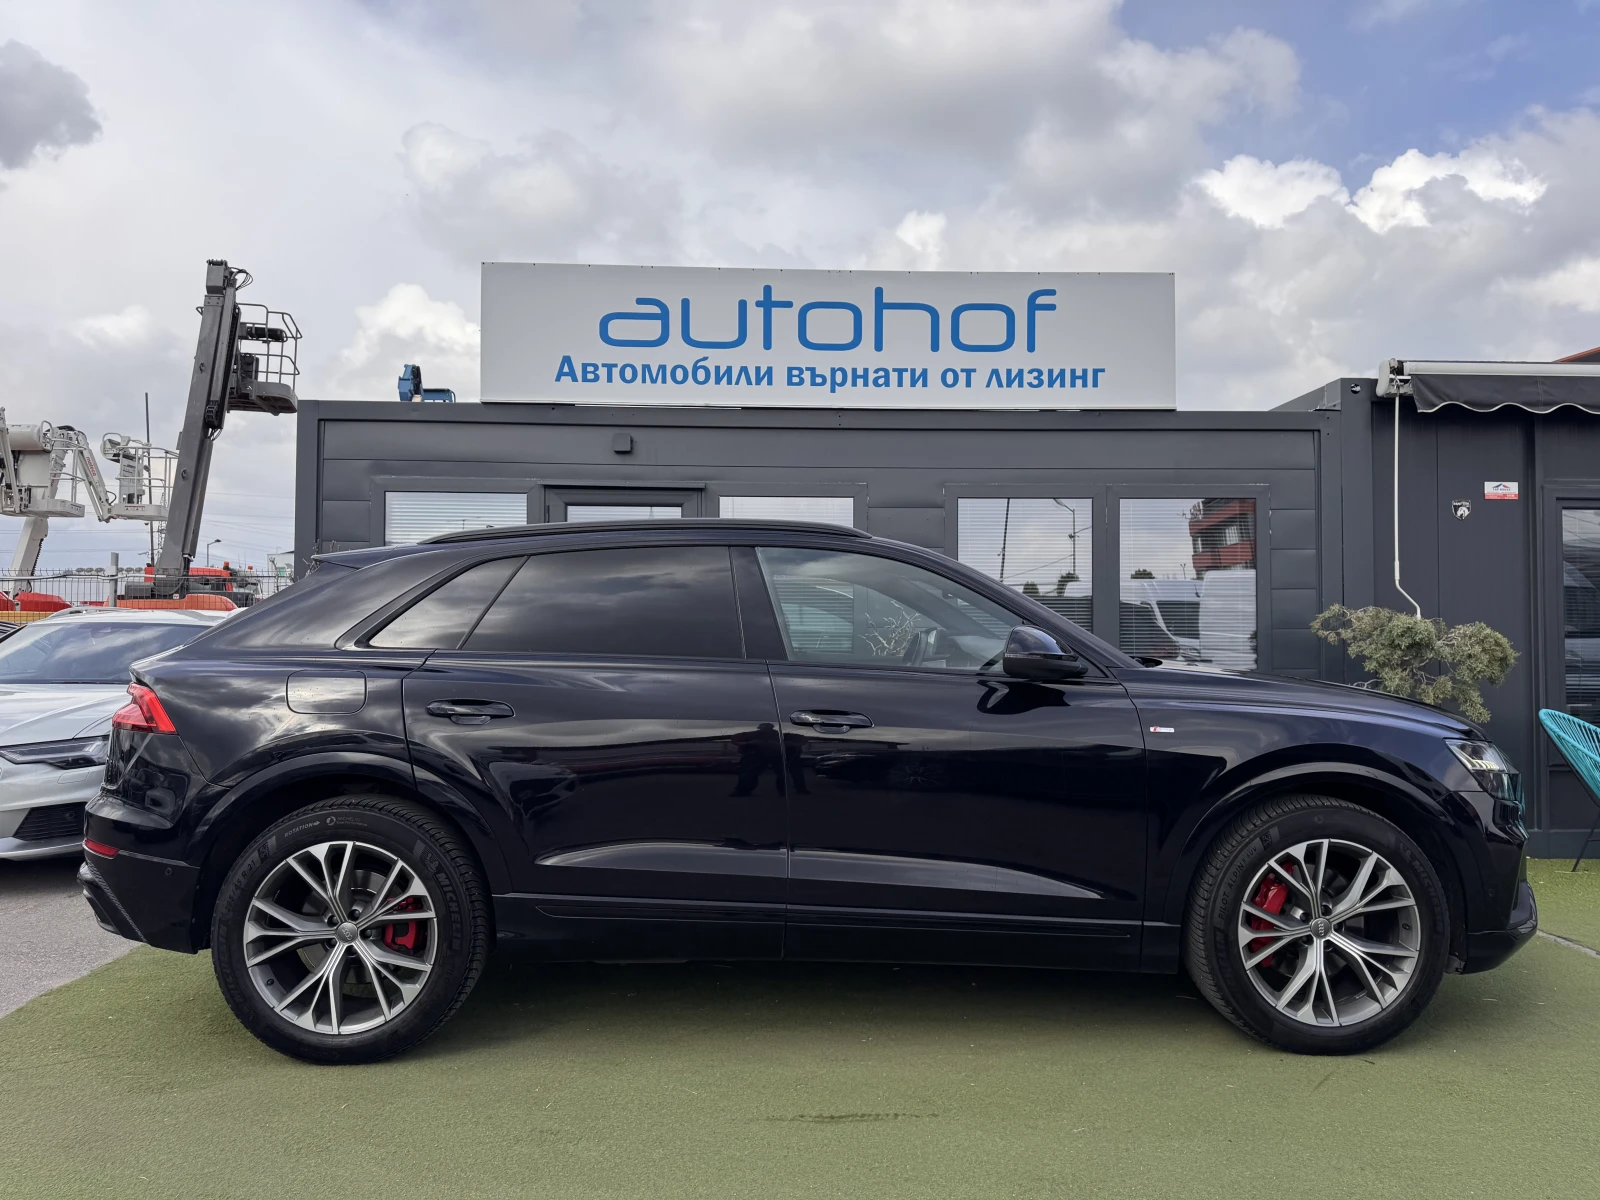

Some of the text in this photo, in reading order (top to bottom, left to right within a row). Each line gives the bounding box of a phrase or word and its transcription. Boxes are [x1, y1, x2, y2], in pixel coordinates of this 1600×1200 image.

[599, 284, 1056, 353] autohof
[555, 355, 1107, 393] Автомобили върнати от лизинг
[284, 822, 313, 838] ROTATION
[247, 859, 257, 871] 21
[1218, 892, 1230, 921] PILOT
[1228, 863, 1245, 890] ALPIN
[1246, 846, 1257, 859] SUV
[435, 871, 463, 951] MICHELIN
